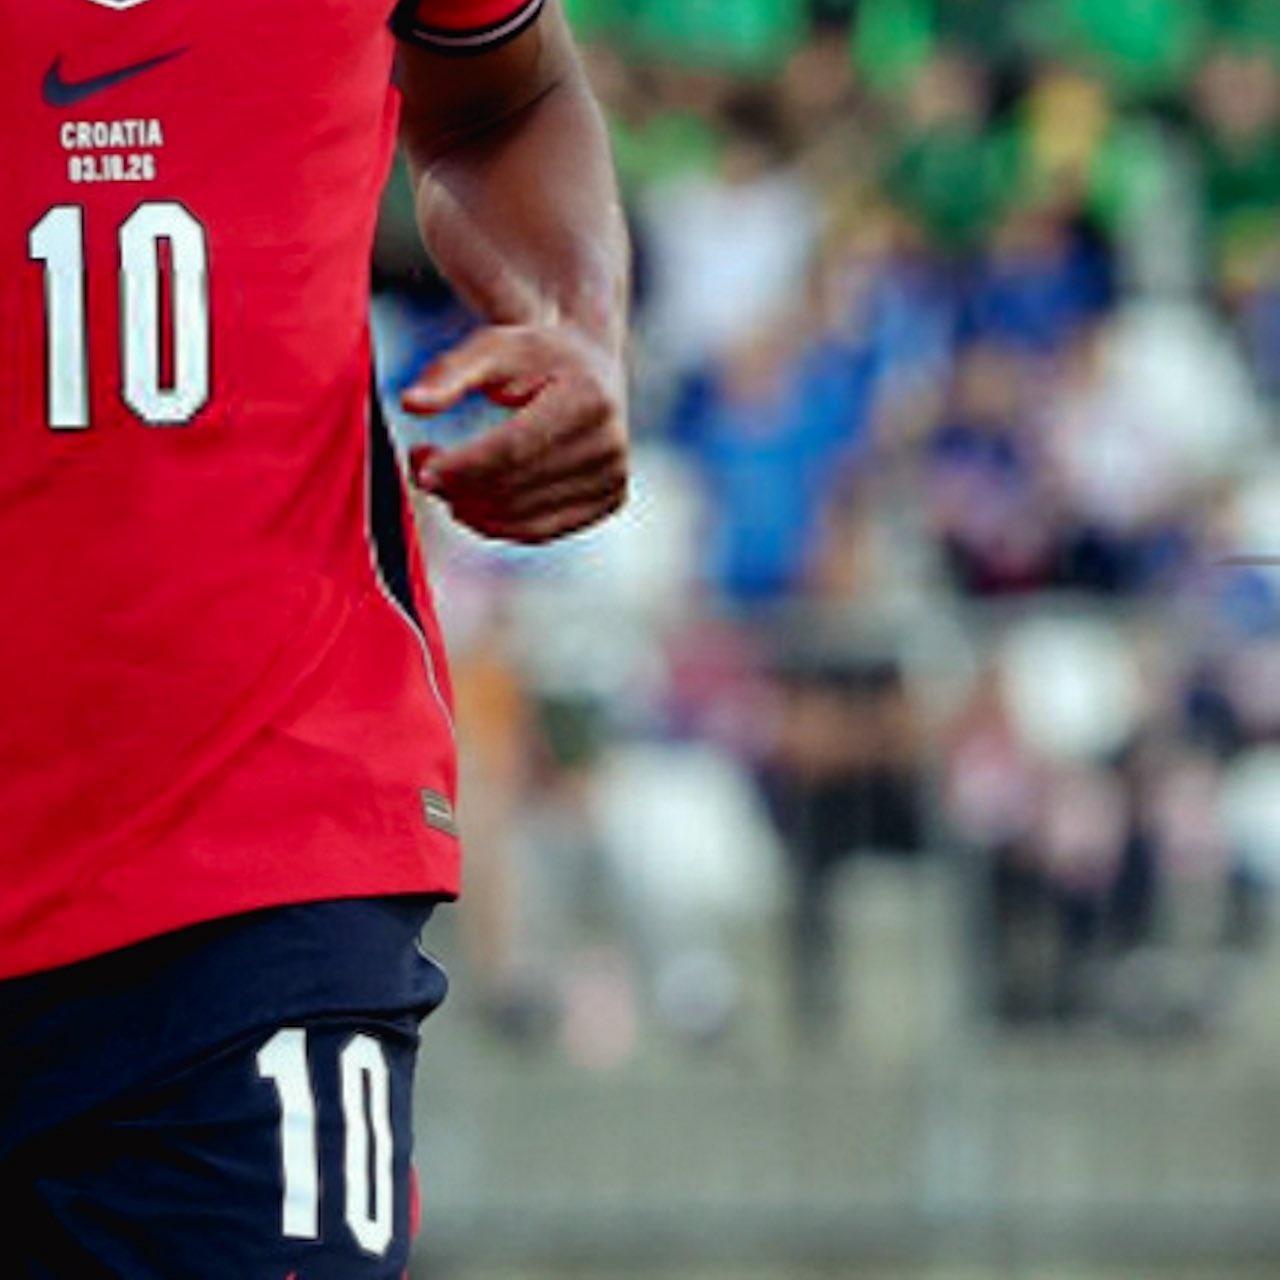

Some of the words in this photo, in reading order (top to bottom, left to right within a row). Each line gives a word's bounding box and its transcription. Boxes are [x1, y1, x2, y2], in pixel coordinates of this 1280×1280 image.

[60, 118, 164, 151] CROATIA
[28, 200, 211, 429] 10
[255, 1027, 394, 1257] 10
